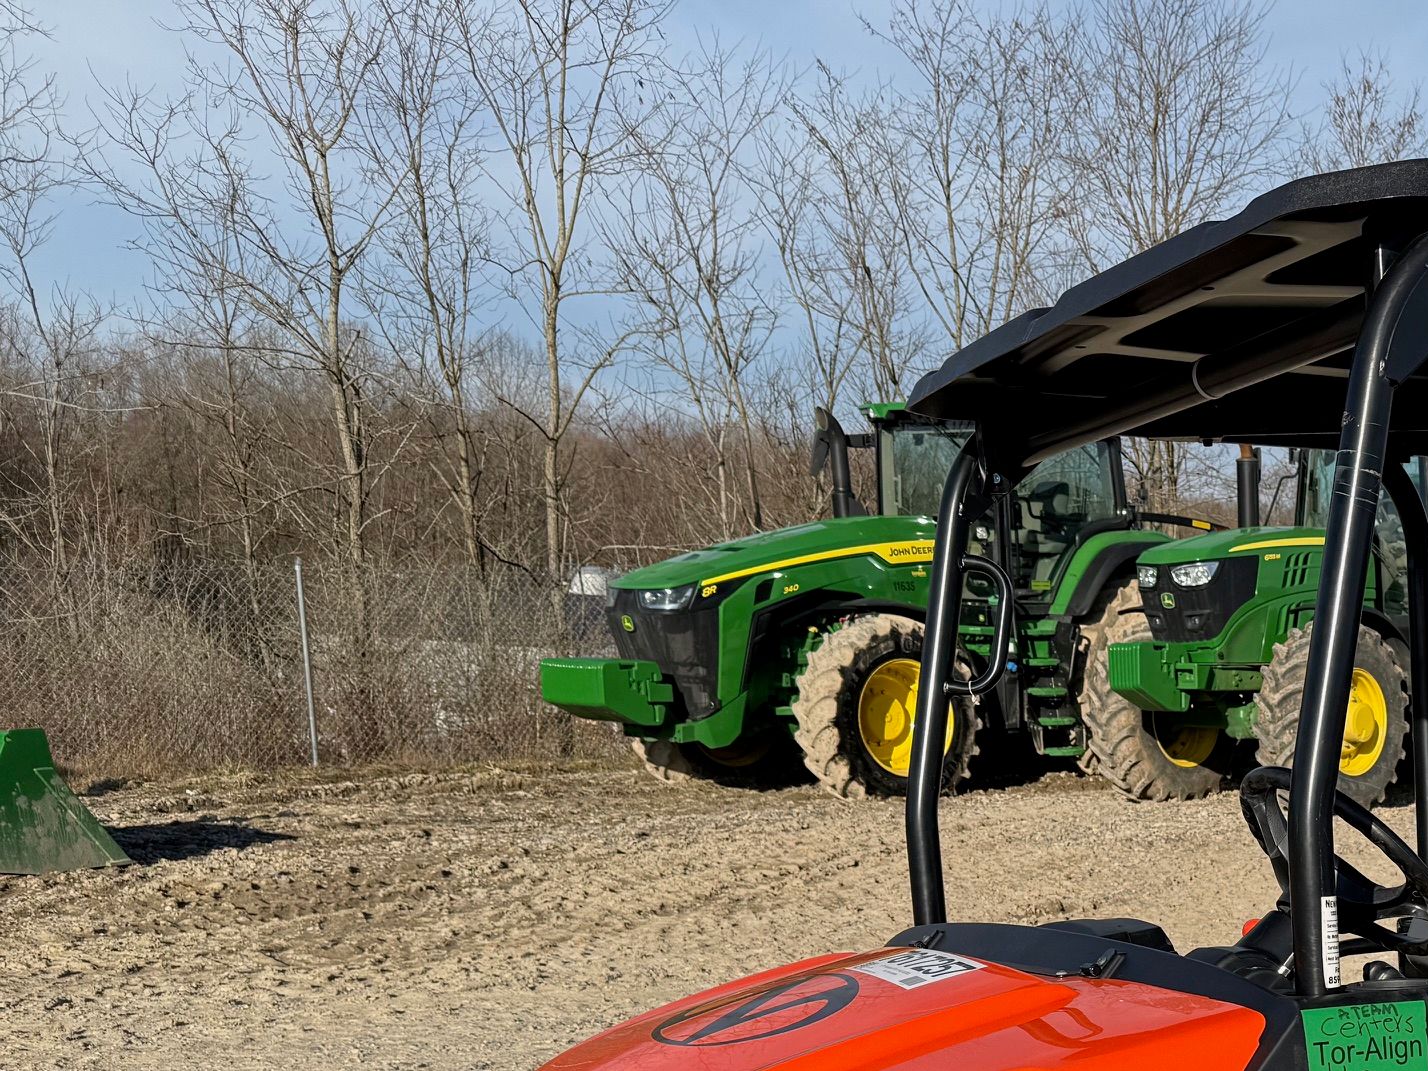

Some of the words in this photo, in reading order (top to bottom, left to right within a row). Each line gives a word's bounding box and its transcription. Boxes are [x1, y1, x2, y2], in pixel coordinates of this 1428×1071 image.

[889, 547, 911, 557] JOHN
[702, 585, 717, 598] 8R
[783, 584, 799, 595] 340
[1338, 1008, 1350, 1020] A
[1351, 1004, 1398, 1020] TEAM
[1320, 1014, 1415, 1039] Centers
[1313, 1035, 1424, 1067] Tor-Align
